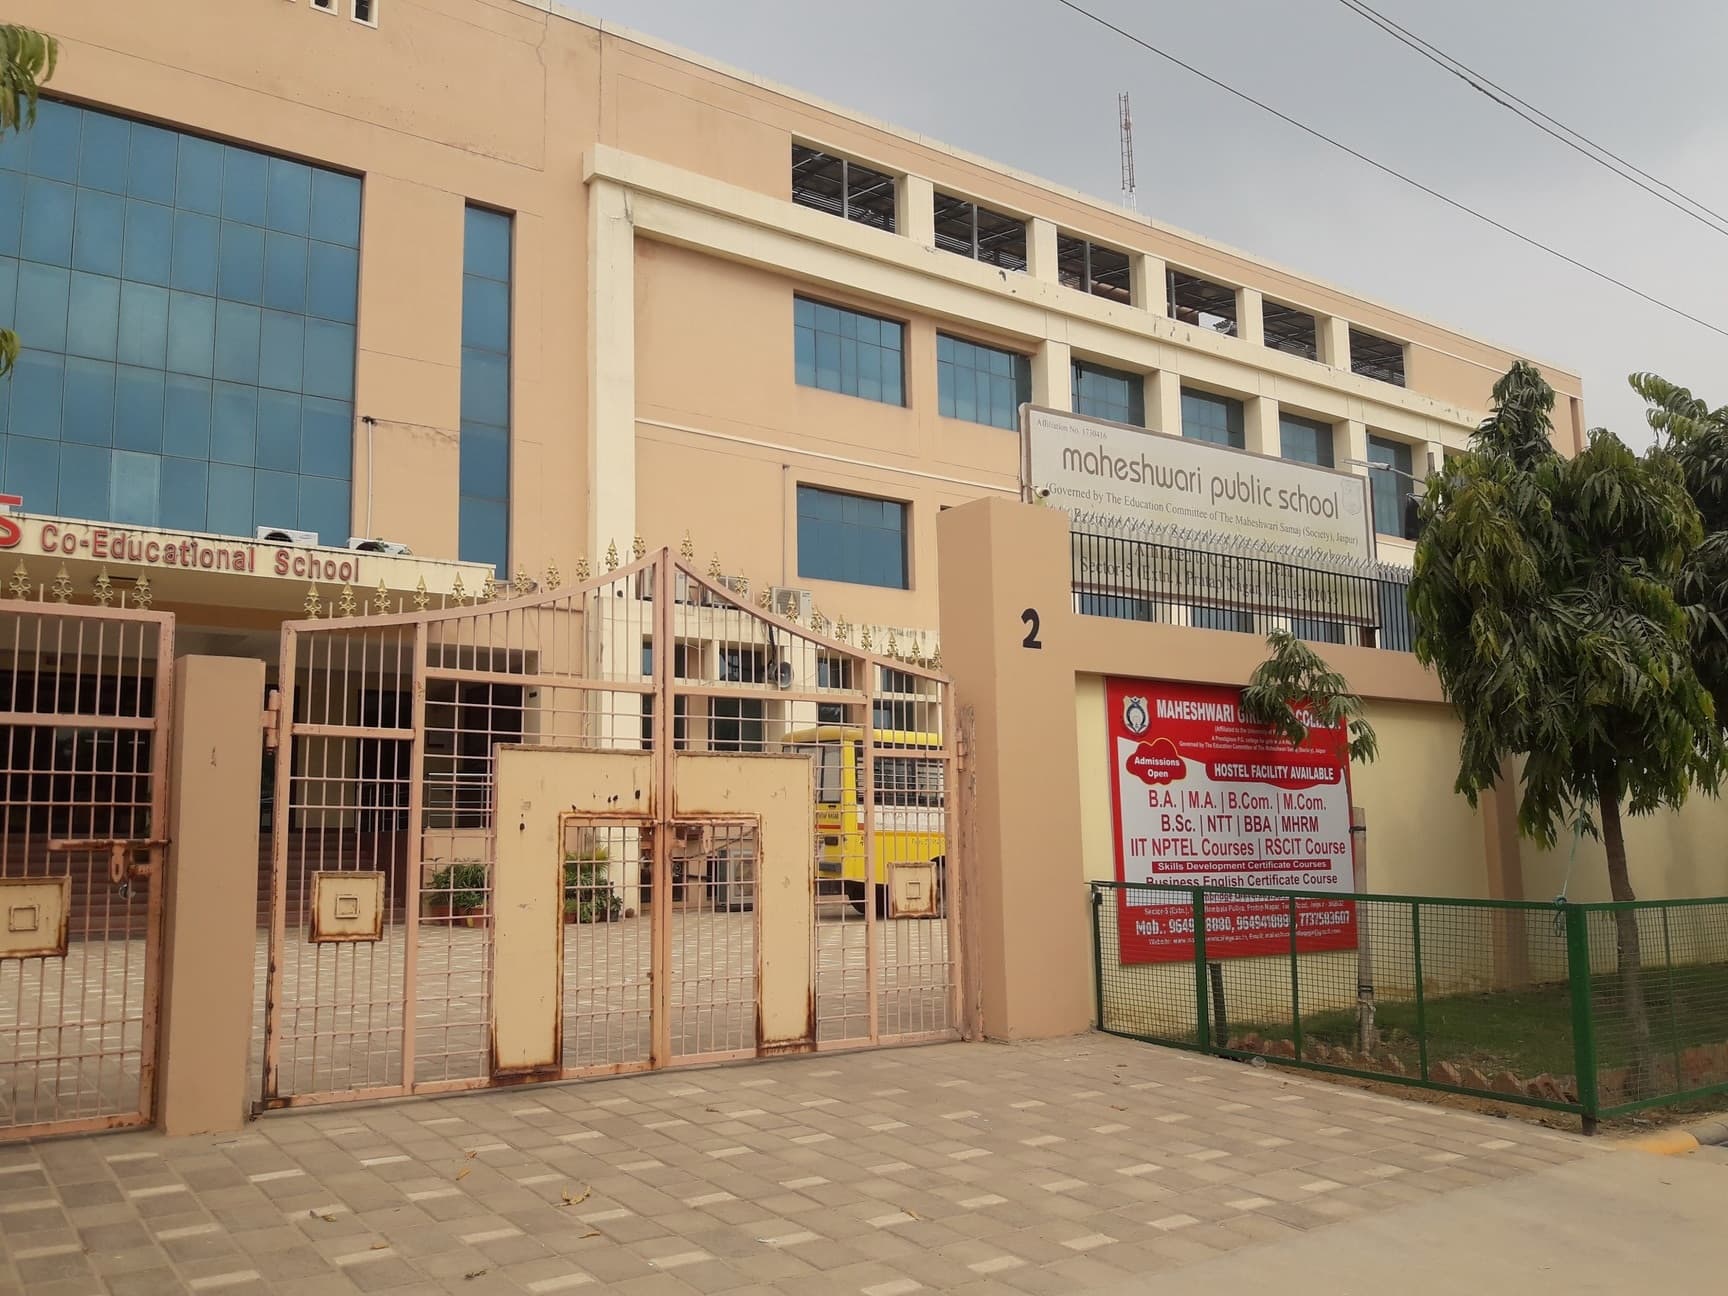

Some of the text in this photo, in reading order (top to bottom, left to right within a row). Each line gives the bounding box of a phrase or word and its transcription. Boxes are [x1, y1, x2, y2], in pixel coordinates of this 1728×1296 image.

[1063, 445, 1339, 519] maheshwari public school
[1093, 490, 1104, 504] by
[1106, 492, 1122, 505] The
[1124, 496, 1164, 511] Education
[1165, 503, 1208, 519] Committee
[1209, 511, 1219, 520] of
[1220, 511, 1233, 523] The
[1235, 516, 1279, 531] Maheshwari
[41, 523, 359, 582] Co-Educational School
[1021, 607, 1042, 649] 2
[1156, 699, 1235, 722] MAHESHWARI
[1134, 756, 1180, 766] Admissions
[1147, 768, 1169, 779] Open
[1214, 763, 1334, 780] HOSTEL FACILITY AVAILABLE
[1148, 789, 1327, 811] B.A. M.A. B.Com. M.Com.
[1161, 814, 1319, 833] B.Sc. NTT BBA MHRM
[1131, 837, 1346, 857] IIT NPTEL Courses RSCIT Course
[1158, 860, 1328, 871] Skills Development Certificate Courses
[1203, 875, 1244, 888] English
[1247, 874, 1300, 887] Certificate
[1302, 873, 1338, 885] Course
